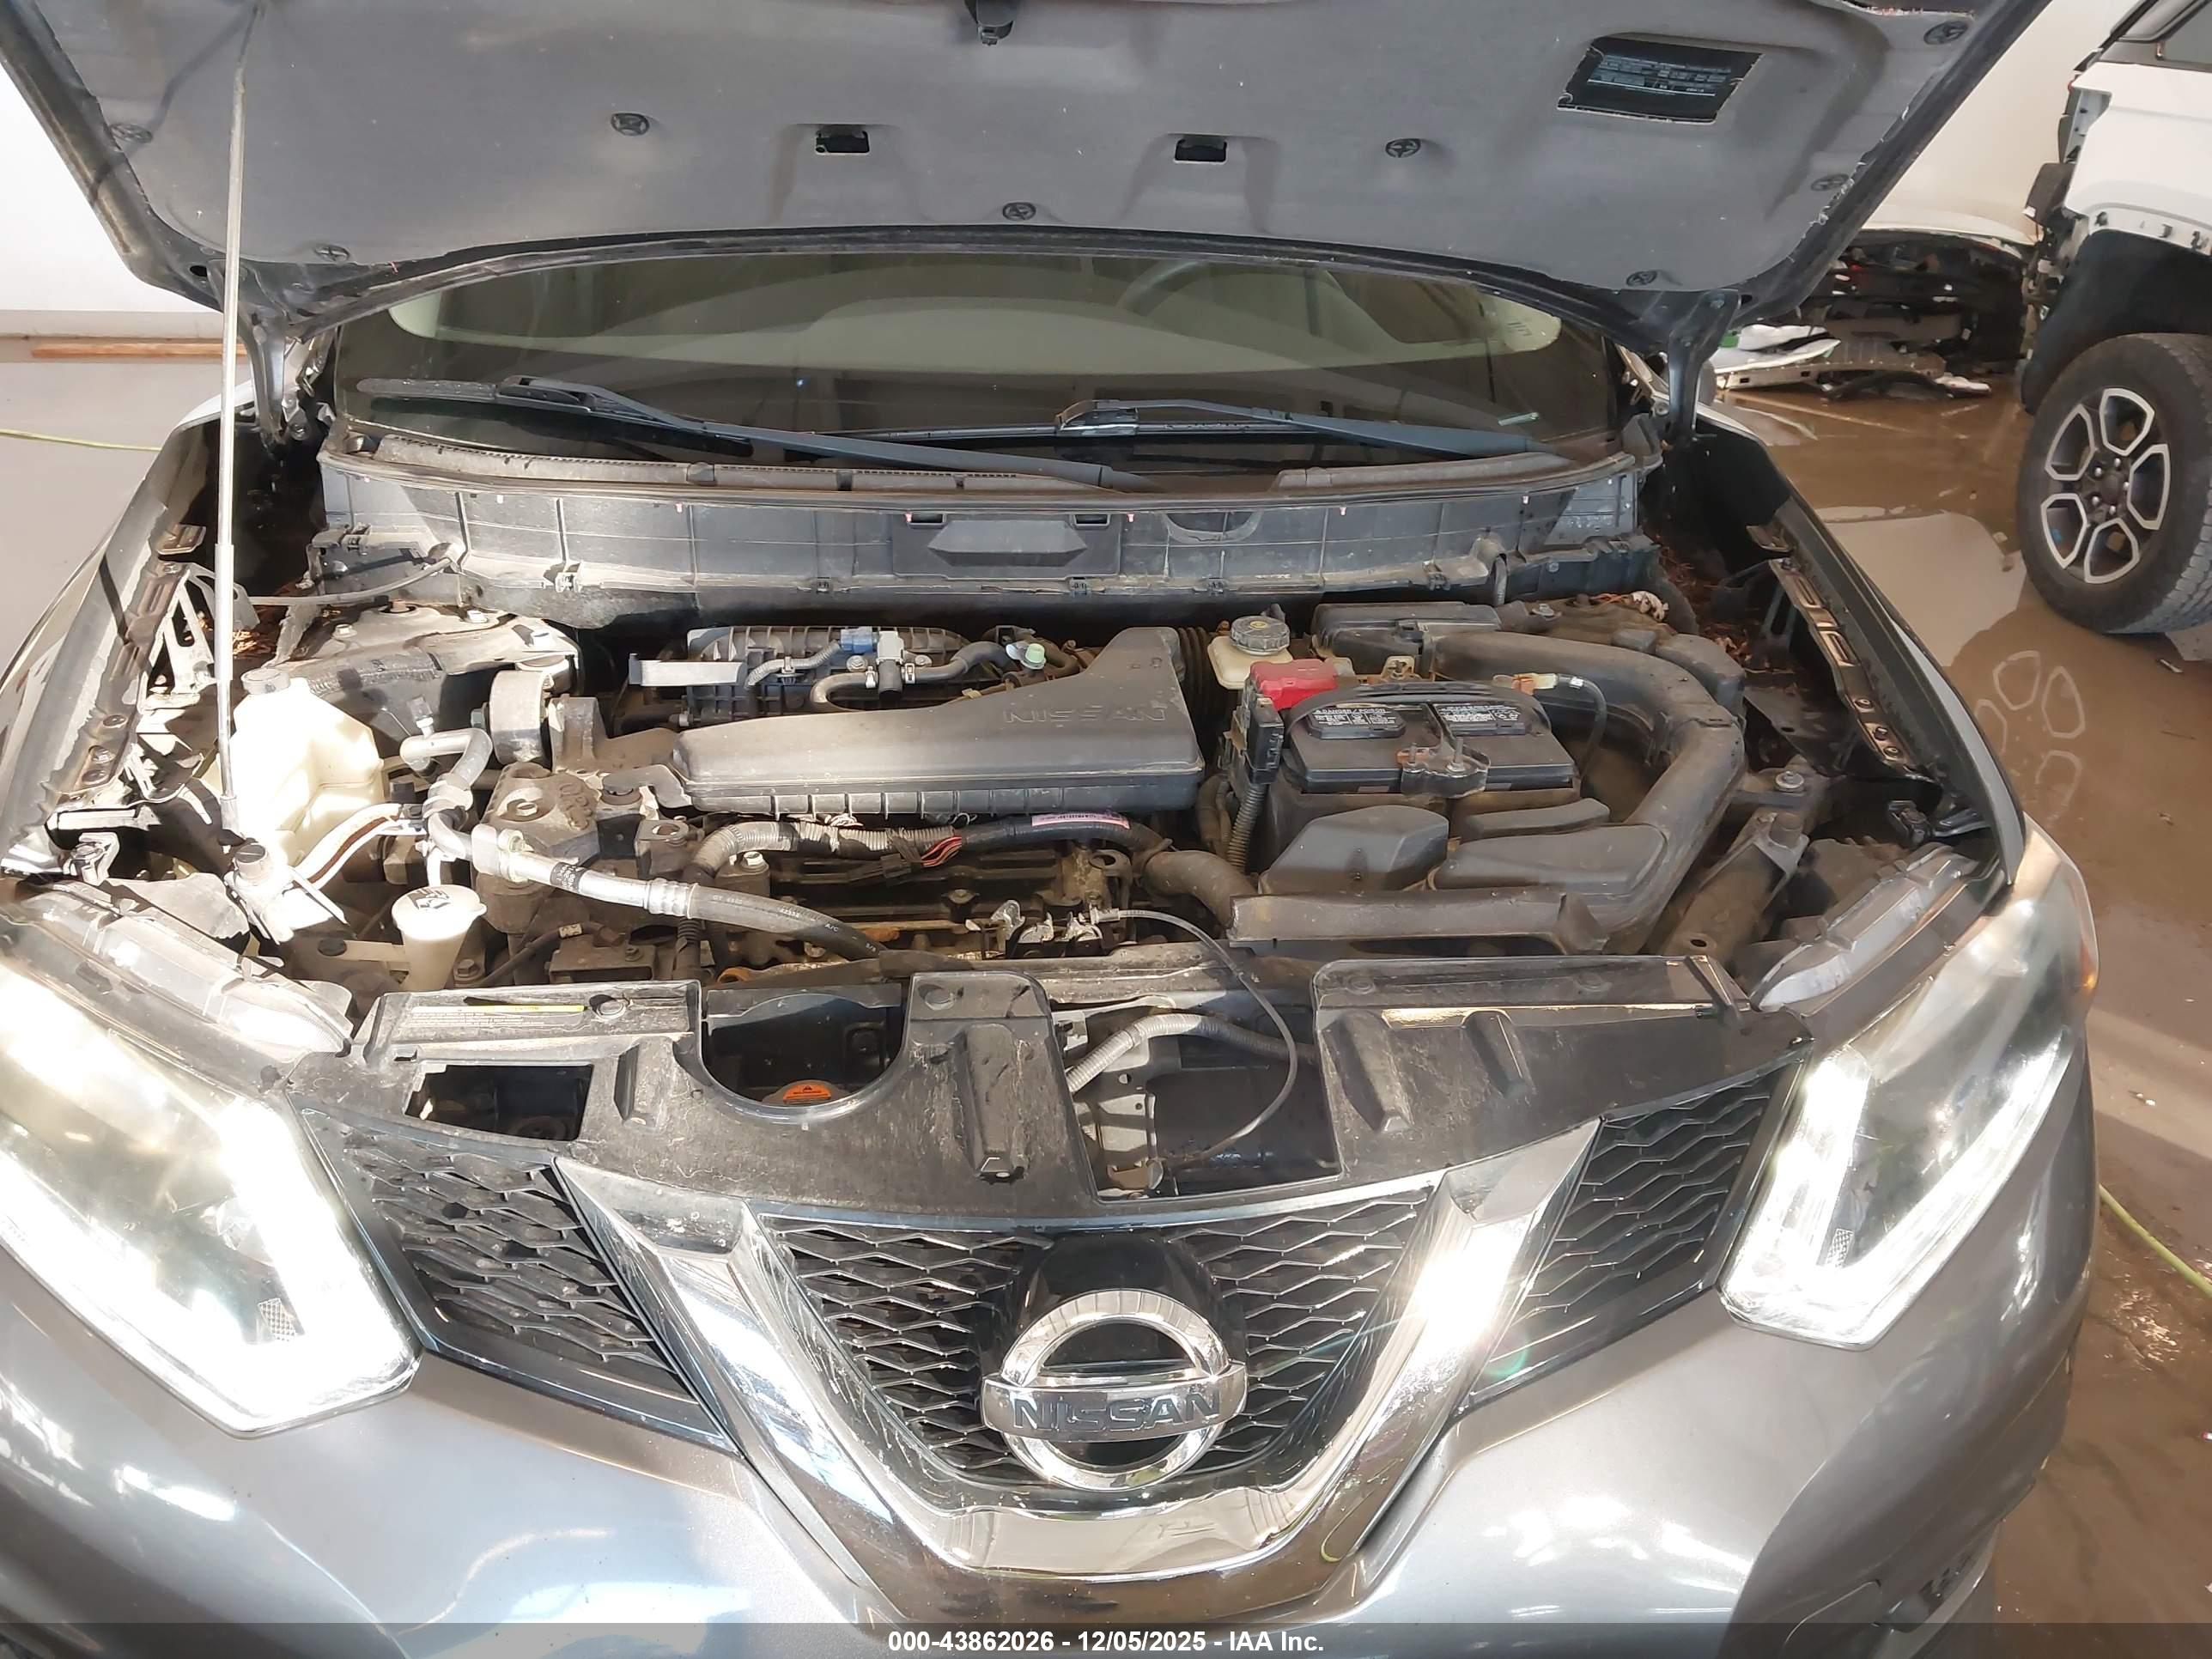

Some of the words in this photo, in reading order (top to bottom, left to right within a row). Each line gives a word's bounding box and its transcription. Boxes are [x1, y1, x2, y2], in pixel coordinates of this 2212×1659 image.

[1003, 705, 1168, 724] NISSAN
[823, 922, 839, 933] A/C
[1013, 1392, 1220, 1433] NISSAN
